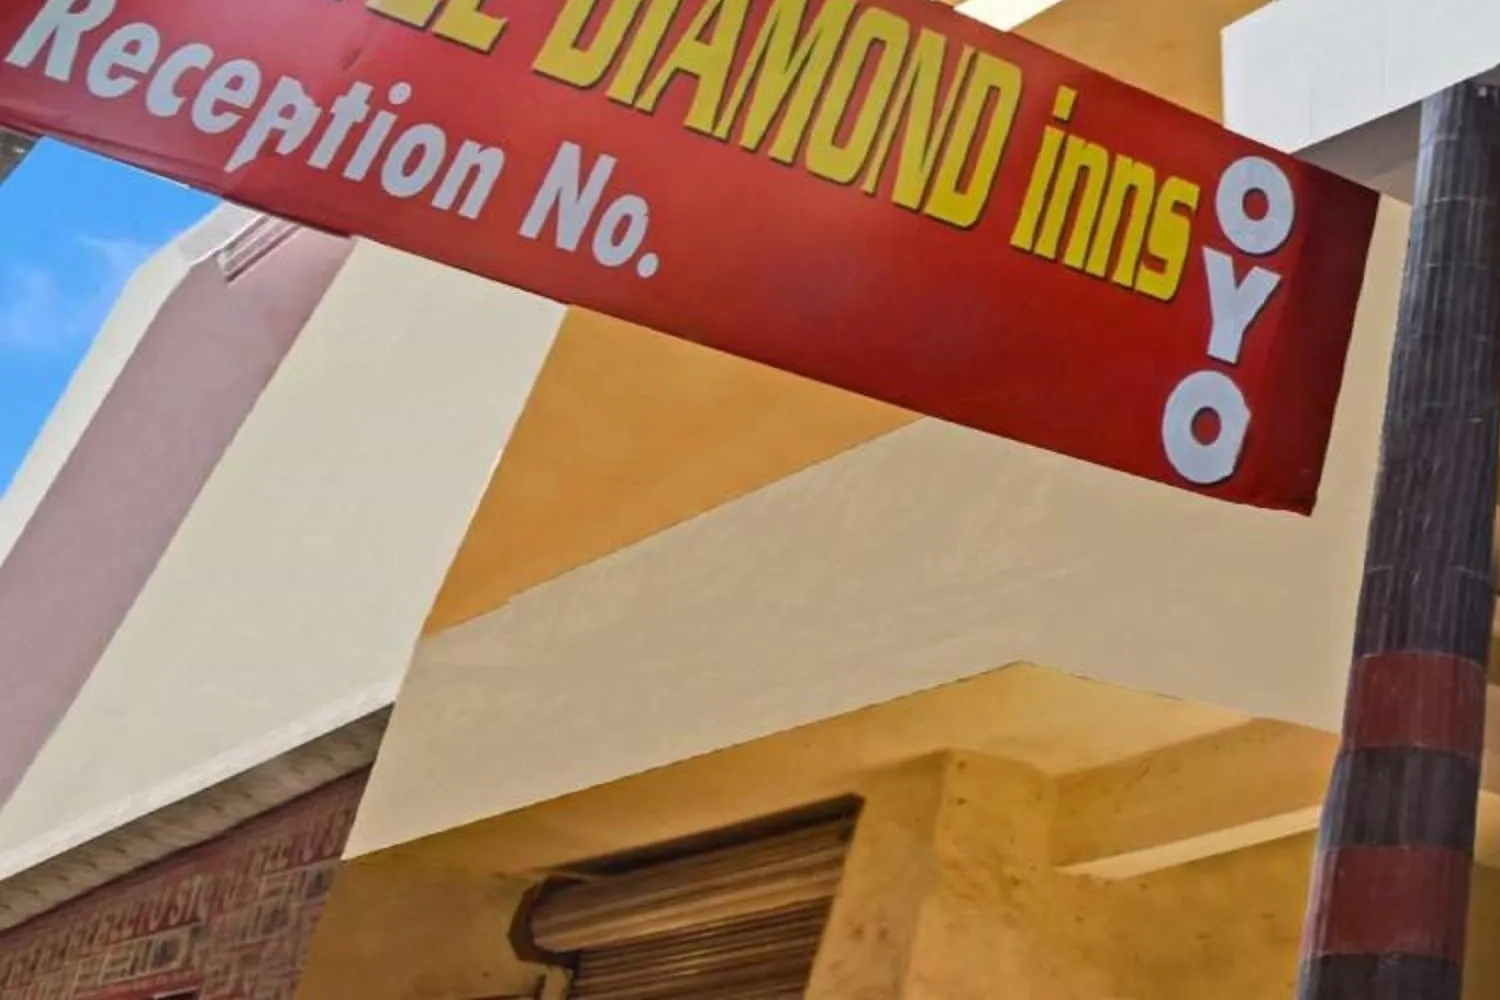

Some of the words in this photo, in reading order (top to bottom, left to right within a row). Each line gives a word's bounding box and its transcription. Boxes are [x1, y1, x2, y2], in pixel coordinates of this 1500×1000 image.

[518, 141, 660, 278] No.
[1010, 86, 1200, 301] inns
[1161, 155, 1295, 485] OYO
